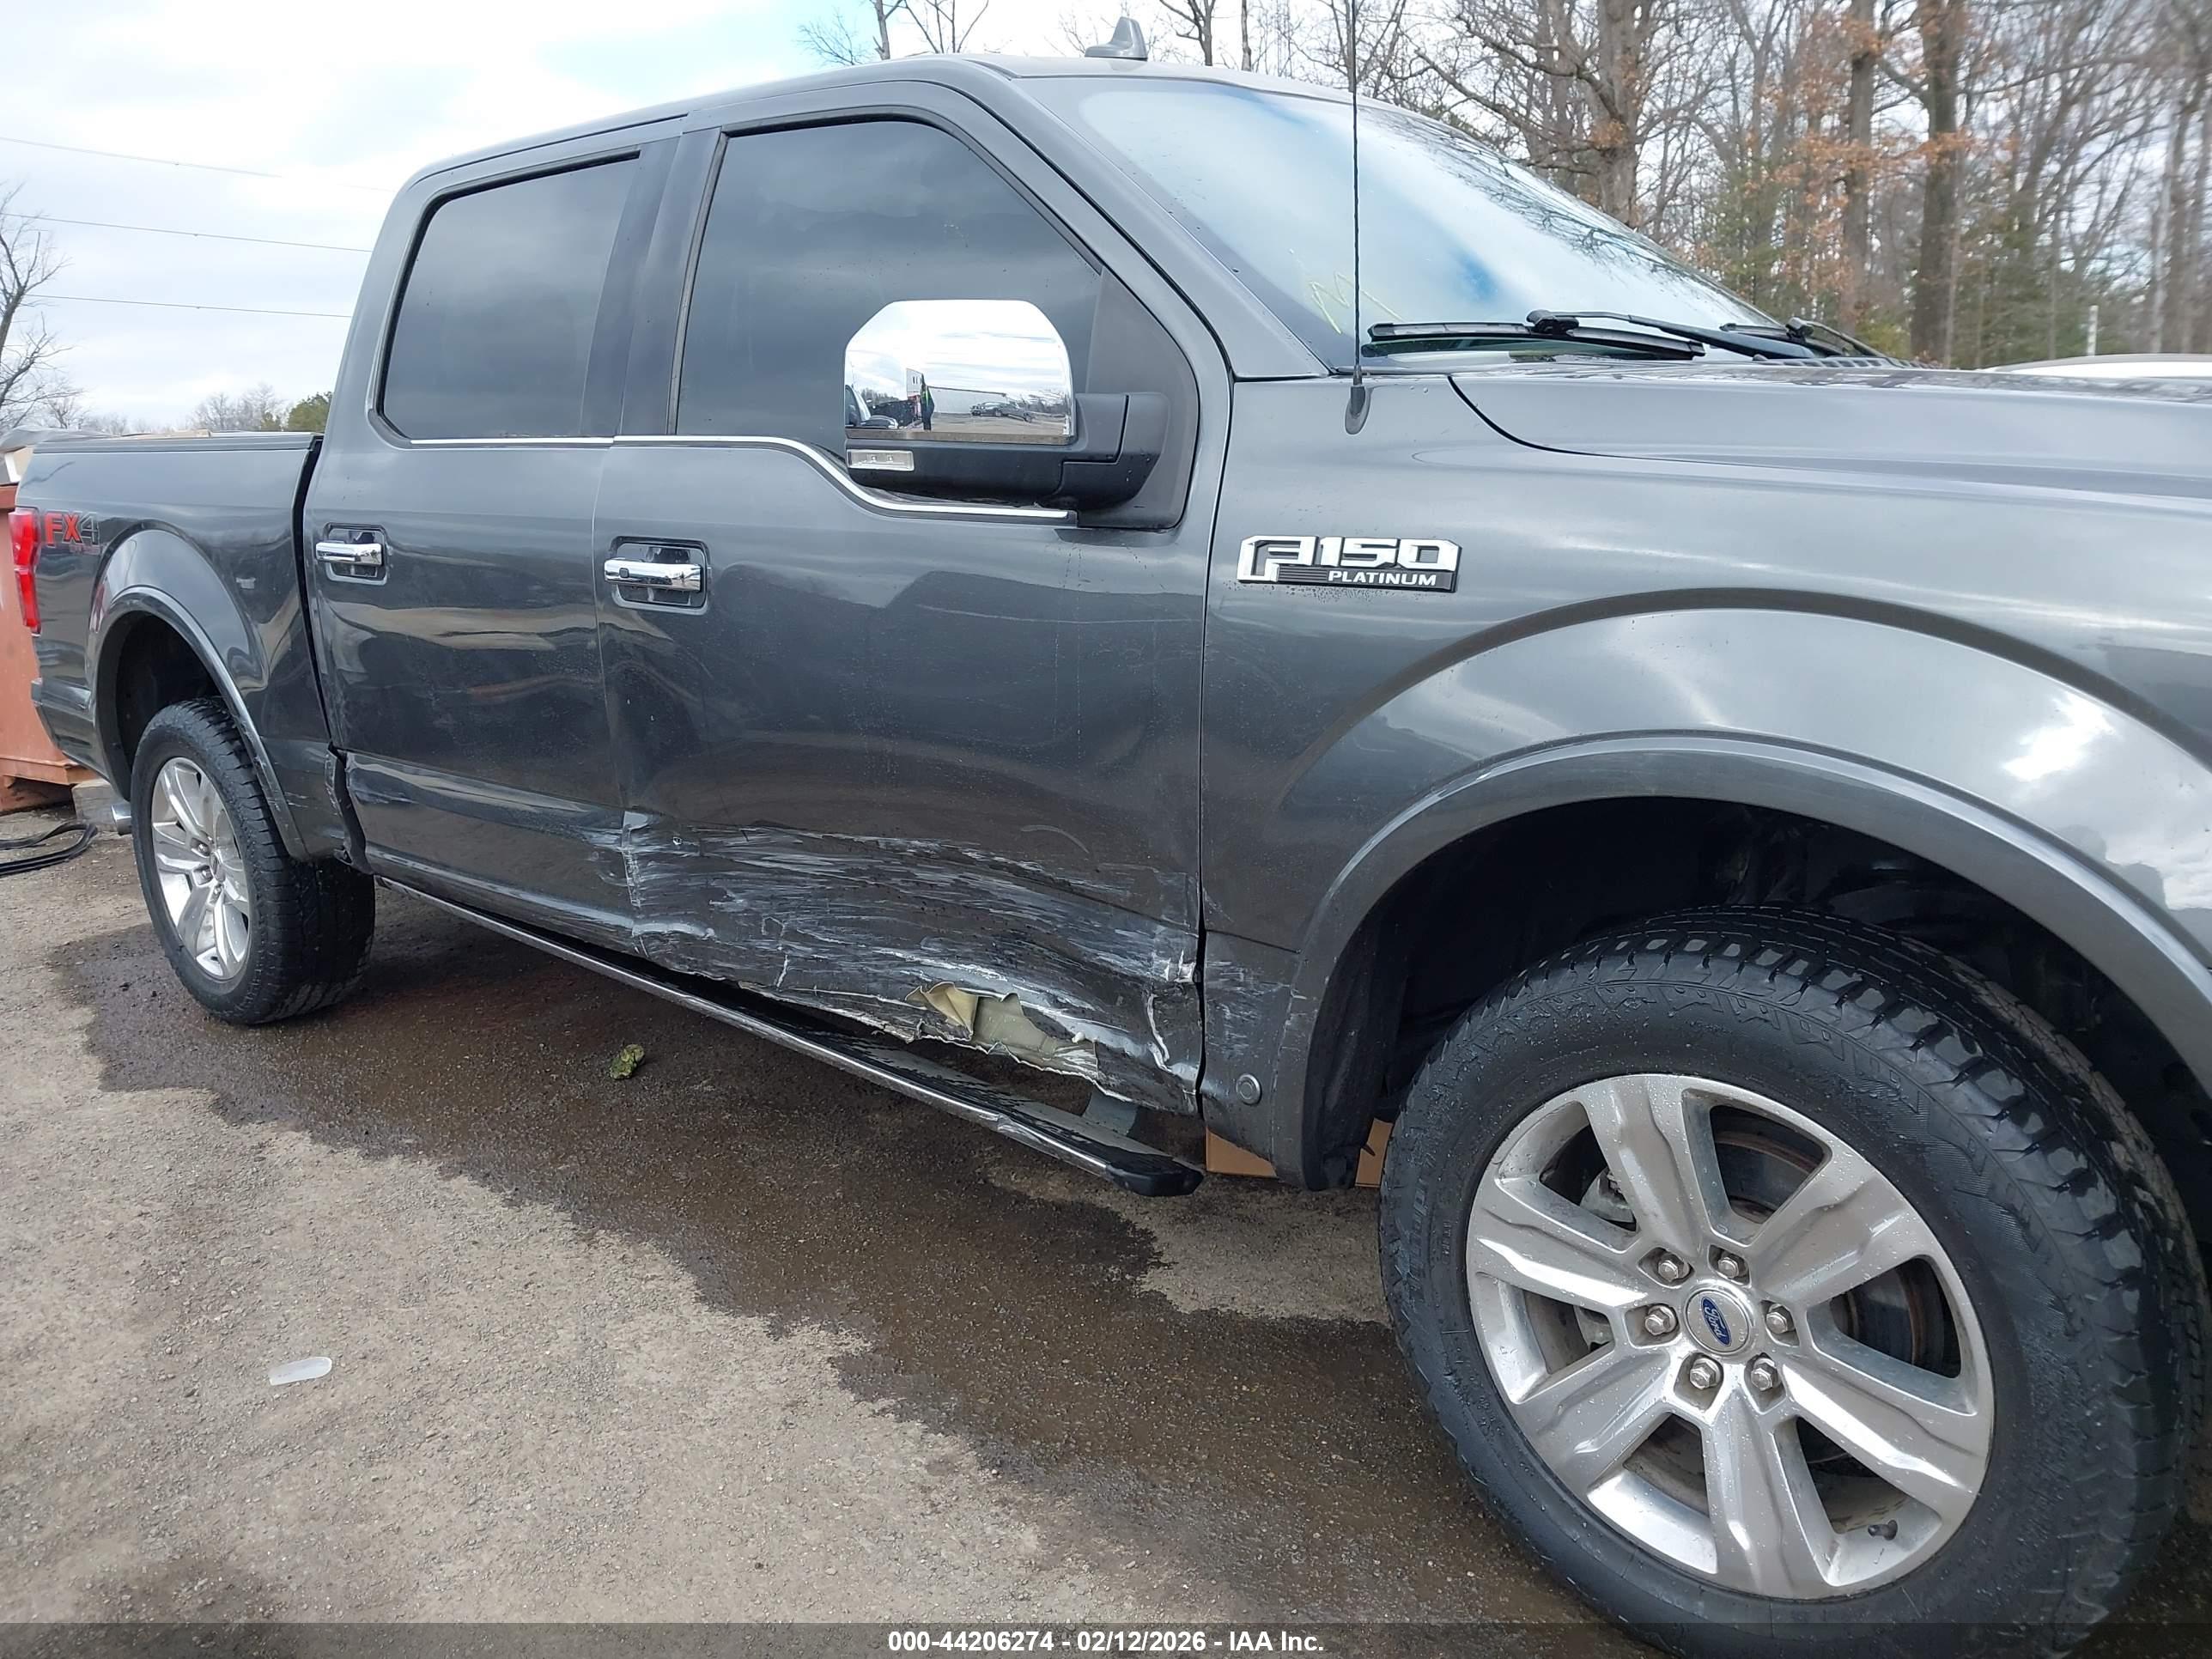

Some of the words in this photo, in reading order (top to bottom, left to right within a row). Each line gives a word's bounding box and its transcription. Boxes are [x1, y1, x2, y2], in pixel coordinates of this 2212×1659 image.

[44, 509, 100, 548] FX4
[1328, 569, 1437, 587] PLATINUM
[1702, 1303, 1728, 1340] Ford
